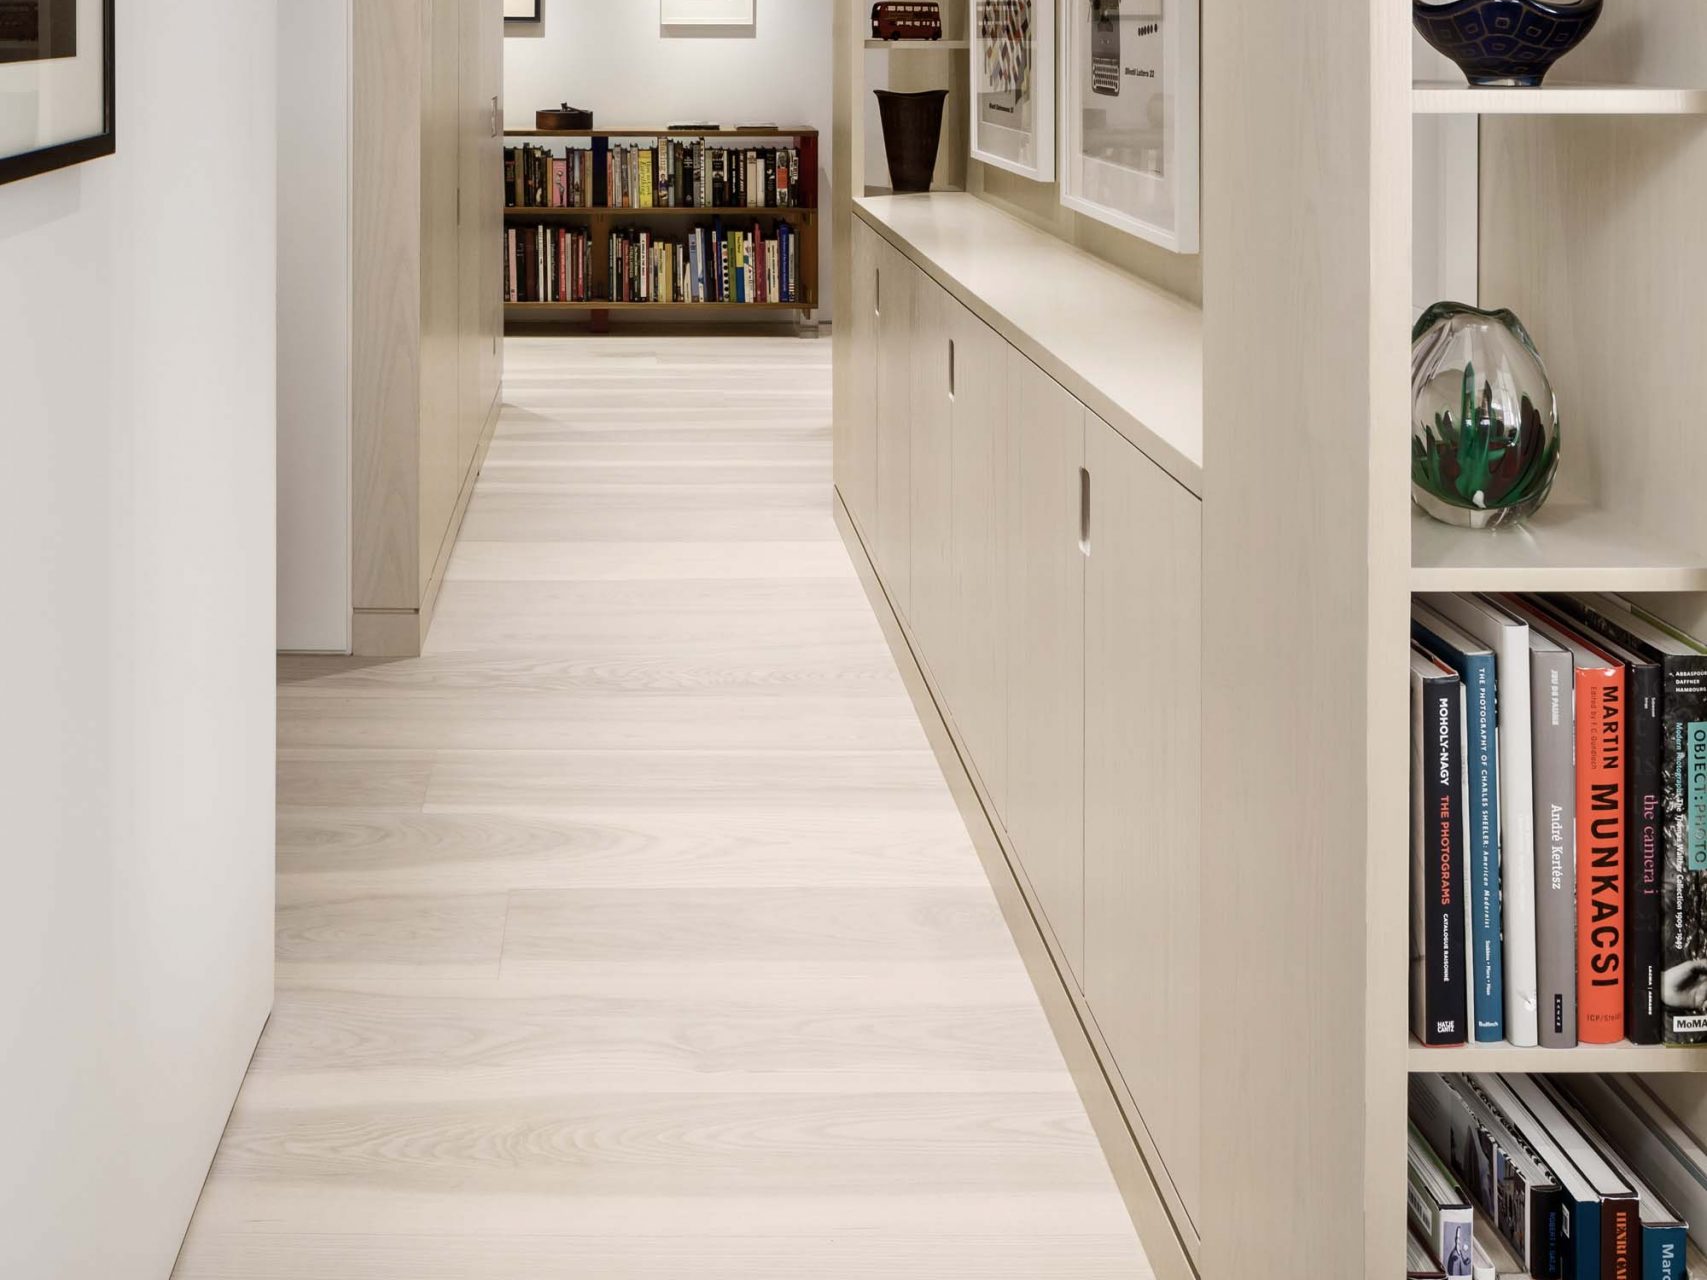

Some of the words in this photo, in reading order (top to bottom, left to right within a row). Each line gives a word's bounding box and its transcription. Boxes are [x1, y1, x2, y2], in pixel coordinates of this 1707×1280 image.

[1551, 670, 1559, 685] JEU
[1551, 686, 1559, 696] DE
[1479, 688, 1487, 751] PHOTOGRAPHY
[1551, 697, 1560, 726] PAUME
[1589, 711, 1597, 719] by
[1602, 686, 1619, 769] MARTIN
[1439, 698, 1449, 786] MOHOLY-NAGY
[1590, 736, 1598, 770] Gundlach
[1675, 722, 1683, 750] Modern
[1480, 755, 1488, 766] OF
[1440, 795, 1449, 818] THE
[1644, 794, 1658, 820] the
[1676, 798, 1684, 812] The
[1481, 810, 1489, 848] SHEELER:
[1551, 804, 1564, 841] André
[1675, 814, 1684, 842] Thomas
[1440, 821, 1450, 905] PHOTOGRAMS
[1551, 846, 1564, 890] Kertész
[1643, 826, 1656, 883] camera
[1676, 844, 1684, 872] Walther
[1591, 783, 1619, 987] MUNKACSI
[1676, 874, 1684, 910] Collection
[1483, 890, 1491, 928] Modernist
[1676, 1019, 1707, 1029] MoMA
[1616, 1212, 1627, 1255] HENRI
